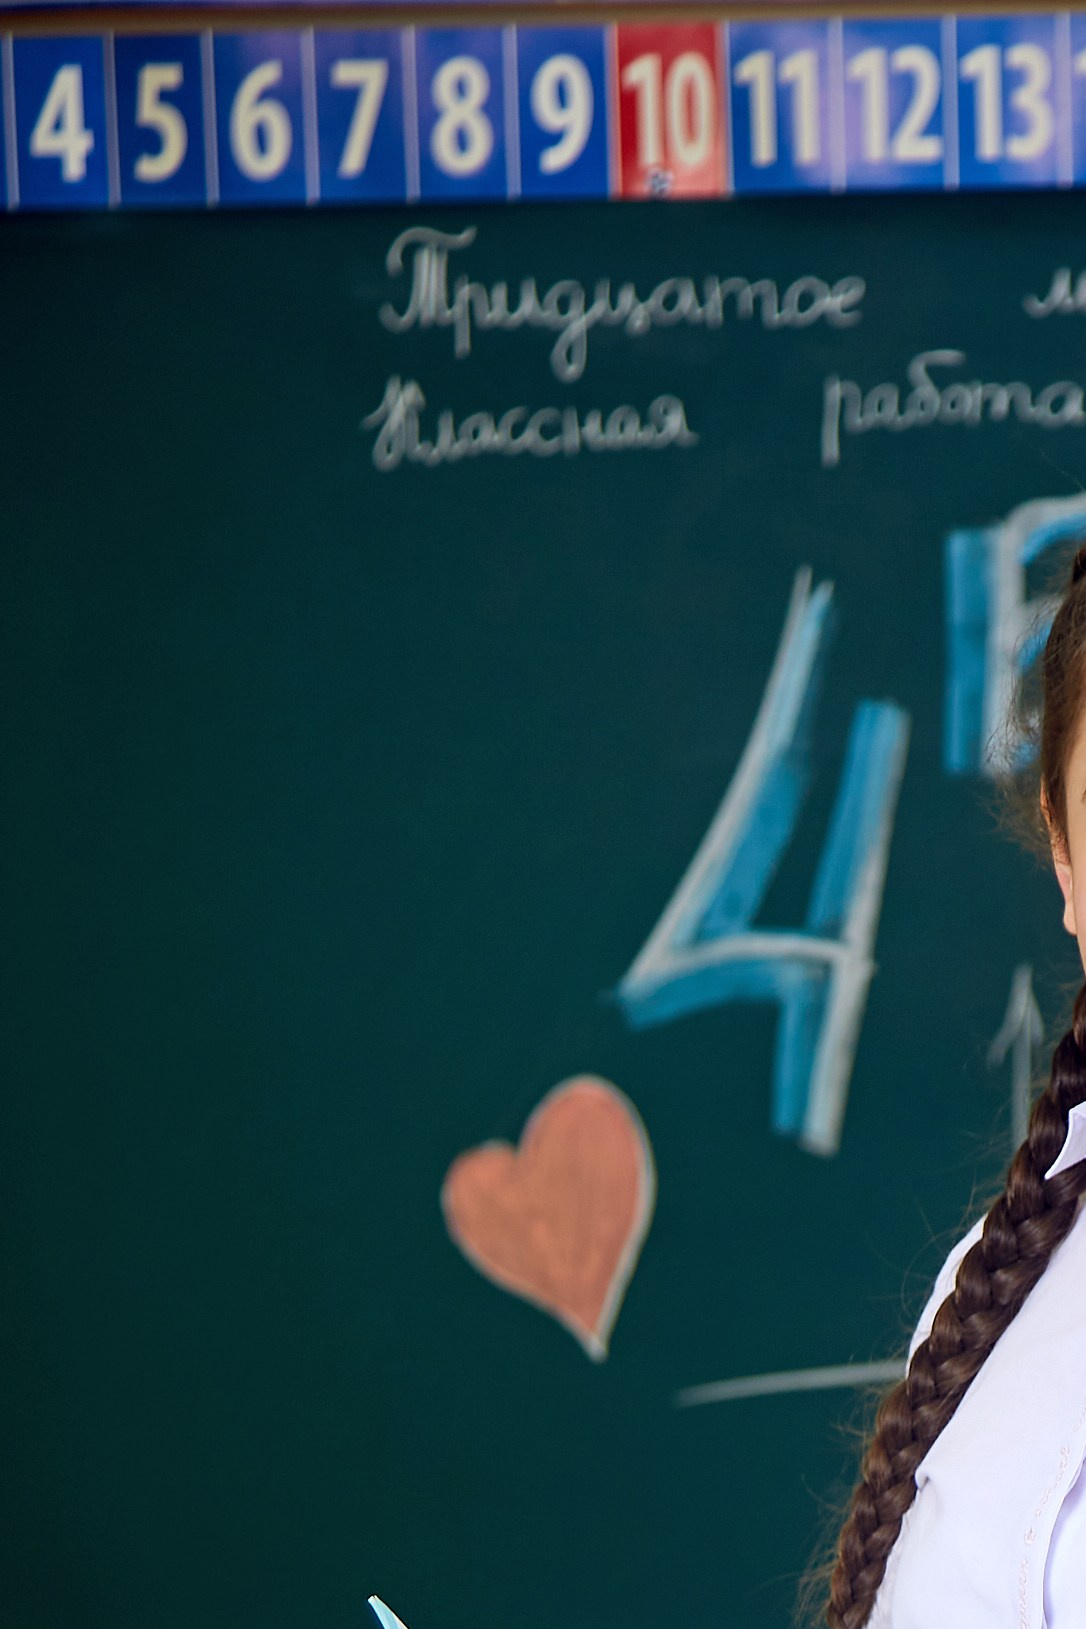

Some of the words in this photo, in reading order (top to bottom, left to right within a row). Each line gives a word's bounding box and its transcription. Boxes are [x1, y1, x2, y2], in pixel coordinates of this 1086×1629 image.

[31, 66, 94, 182] 4
[135, 64, 187, 180] 5
[231, 60, 292, 180] 6
[331, 60, 388, 177] 7
[431, 56, 494, 176] 8
[531, 54, 594, 174] 9
[622, 51, 716, 168] 10
[735, 49, 820, 167] 11
[847, 45, 944, 164] 12
[959, 44, 1054, 162] 13
[379, 226, 866, 382] Тридцатое
